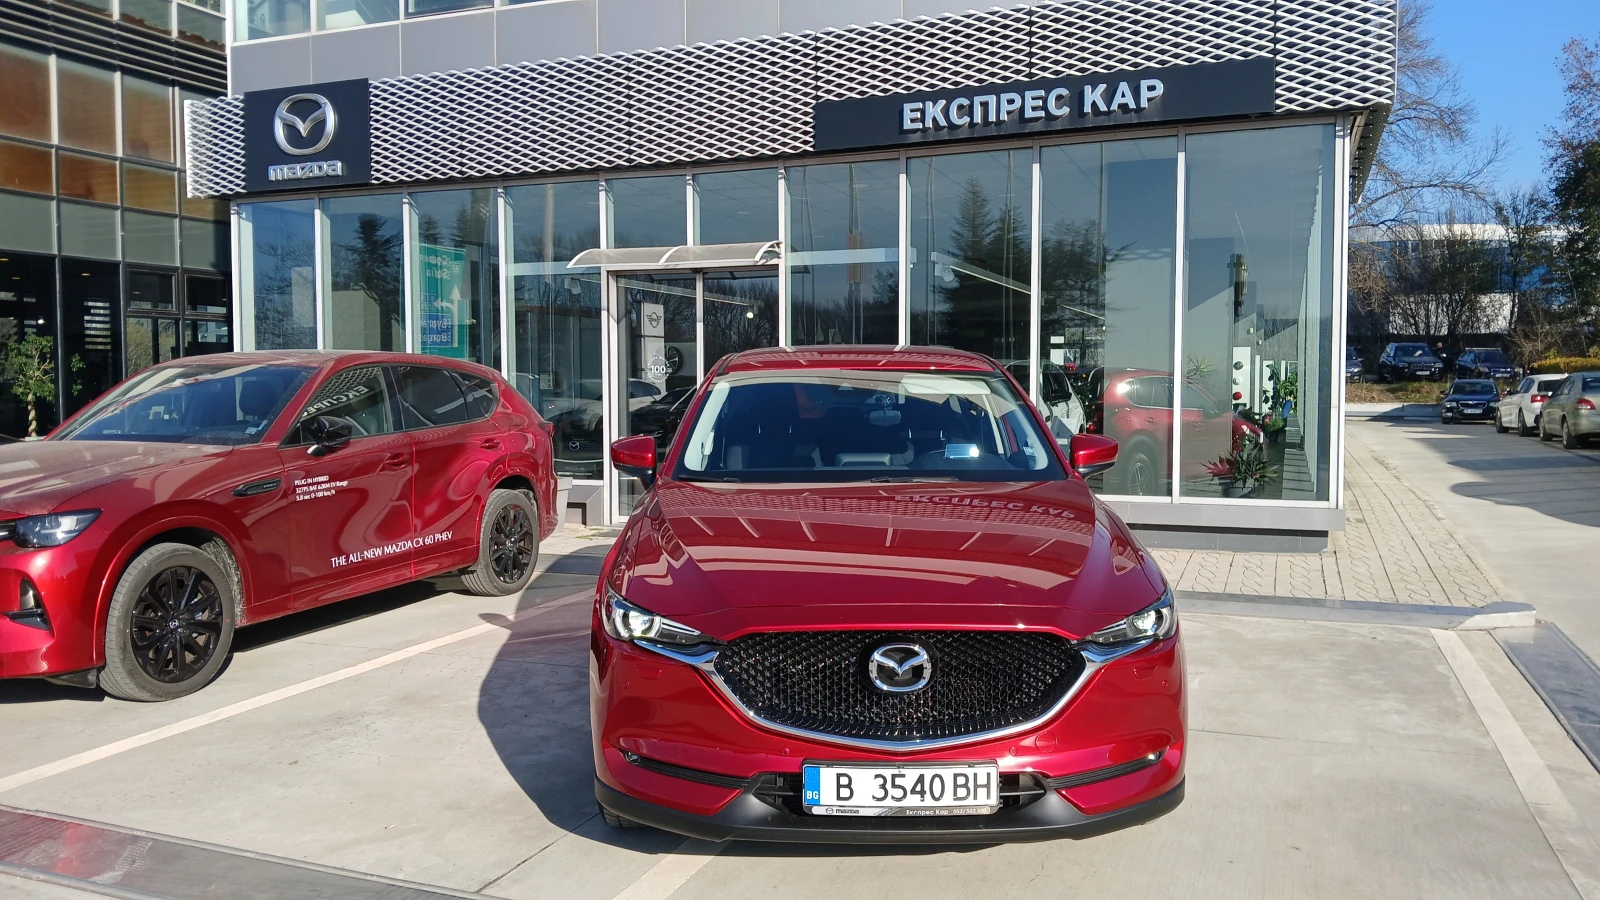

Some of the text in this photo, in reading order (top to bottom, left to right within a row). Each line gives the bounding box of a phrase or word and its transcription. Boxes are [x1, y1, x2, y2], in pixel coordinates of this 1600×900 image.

[902, 78, 1164, 130] ЕКСПРЕС КАР
[650, 365, 666, 374] 100
[330, 530, 453, 568] THE ALL-NEW MAZDA CX 60 PHEV
[806, 790, 820, 800] BG
[836, 772, 991, 802] B 3540 BH
